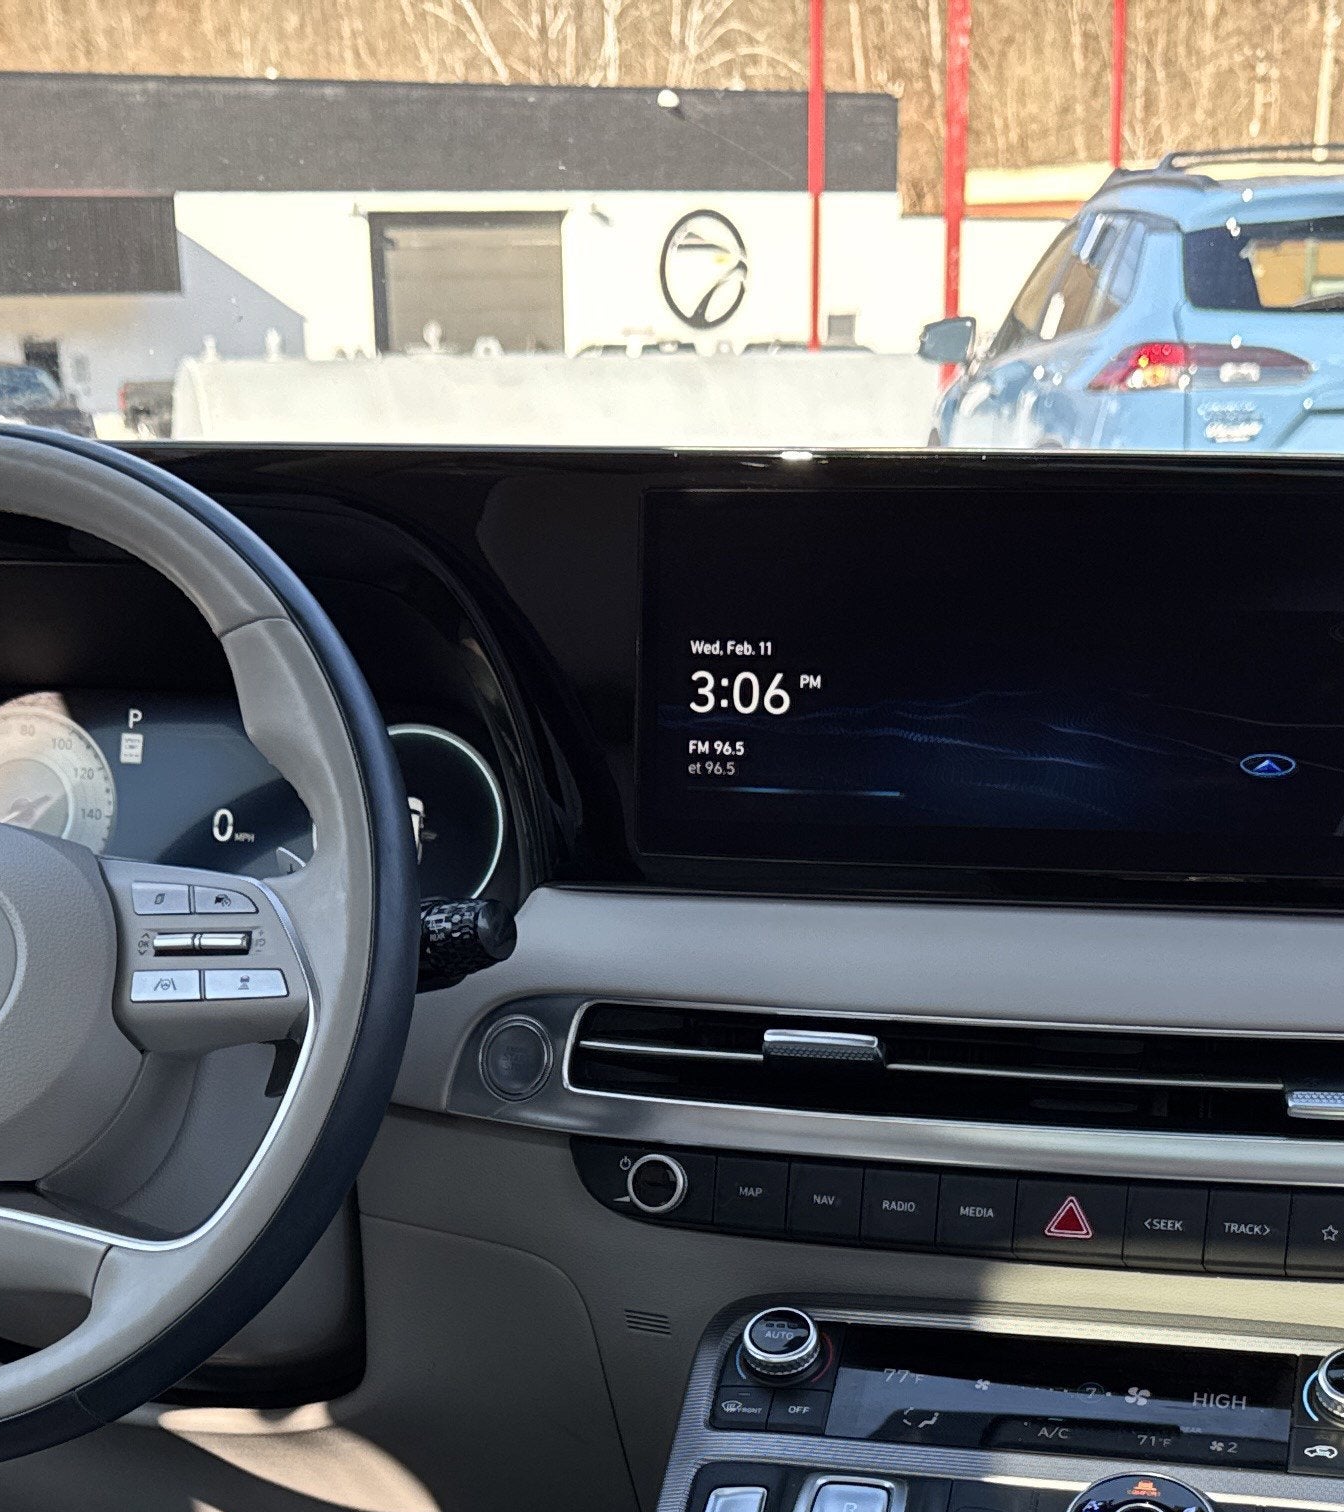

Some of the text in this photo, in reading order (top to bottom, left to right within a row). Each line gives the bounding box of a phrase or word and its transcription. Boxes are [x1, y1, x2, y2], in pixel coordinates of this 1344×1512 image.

[726, 640, 756, 656] Feb.
[759, 641, 772, 655] 11
[689, 670, 822, 715] 3:06 PM
[128, 708, 143, 729] P
[20, 724, 35, 736] 80
[51, 738, 72, 751] 100
[688, 740, 745, 755] FM 96.5
[74, 767, 95, 780] 120
[688, 761, 736, 775] et 96.5
[81, 808, 102, 821] 140
[212, 809, 255, 844] 0 MPH
[739, 1186, 763, 1198] MAP
[813, 1193, 835, 1206] NAV
[882, 1200, 916, 1213] RADIO
[959, 1206, 994, 1219] MEDIA
[765, 1331, 794, 1341] AUTO
[1192, 1392, 1247, 1410] HIGH
[788, 1405, 810, 1414] OFF
[1038, 1427, 1070, 1440] A/C
[1228, 1442, 1238, 1453] 2
